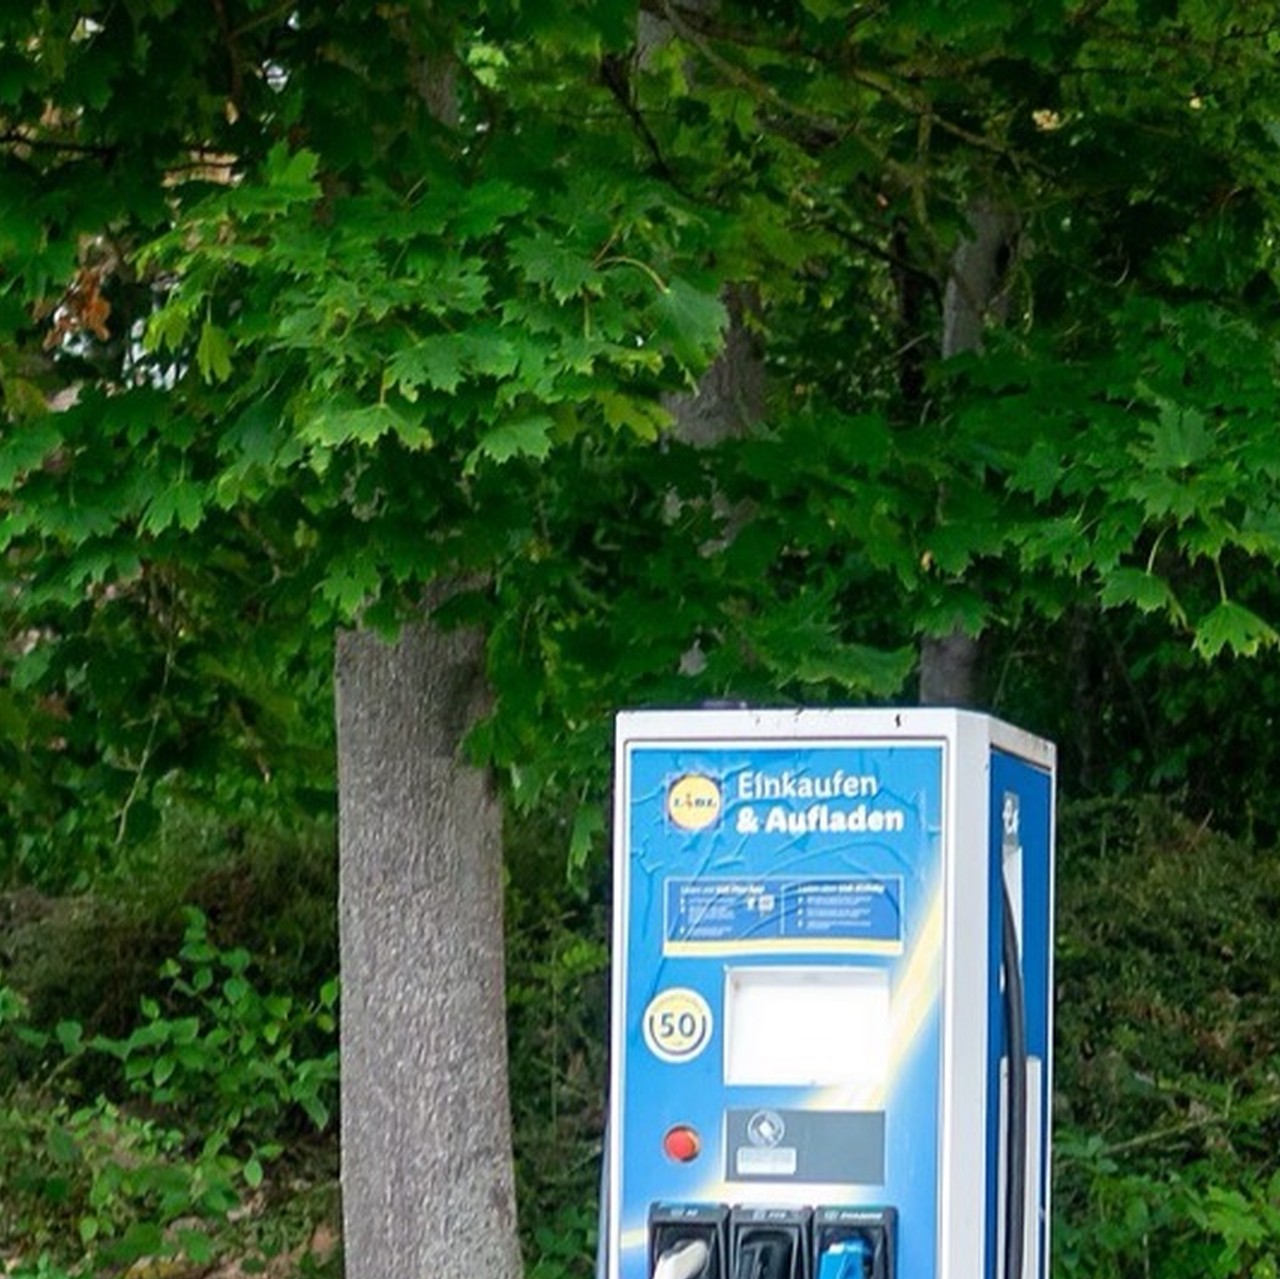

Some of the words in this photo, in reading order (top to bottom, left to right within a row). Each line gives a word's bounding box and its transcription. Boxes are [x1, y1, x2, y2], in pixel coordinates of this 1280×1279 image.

[737, 769, 878, 799] Einkaufen
[736, 805, 759, 834] &
[764, 804, 905, 834] Aufladen
[660, 1012, 697, 1039] 50
